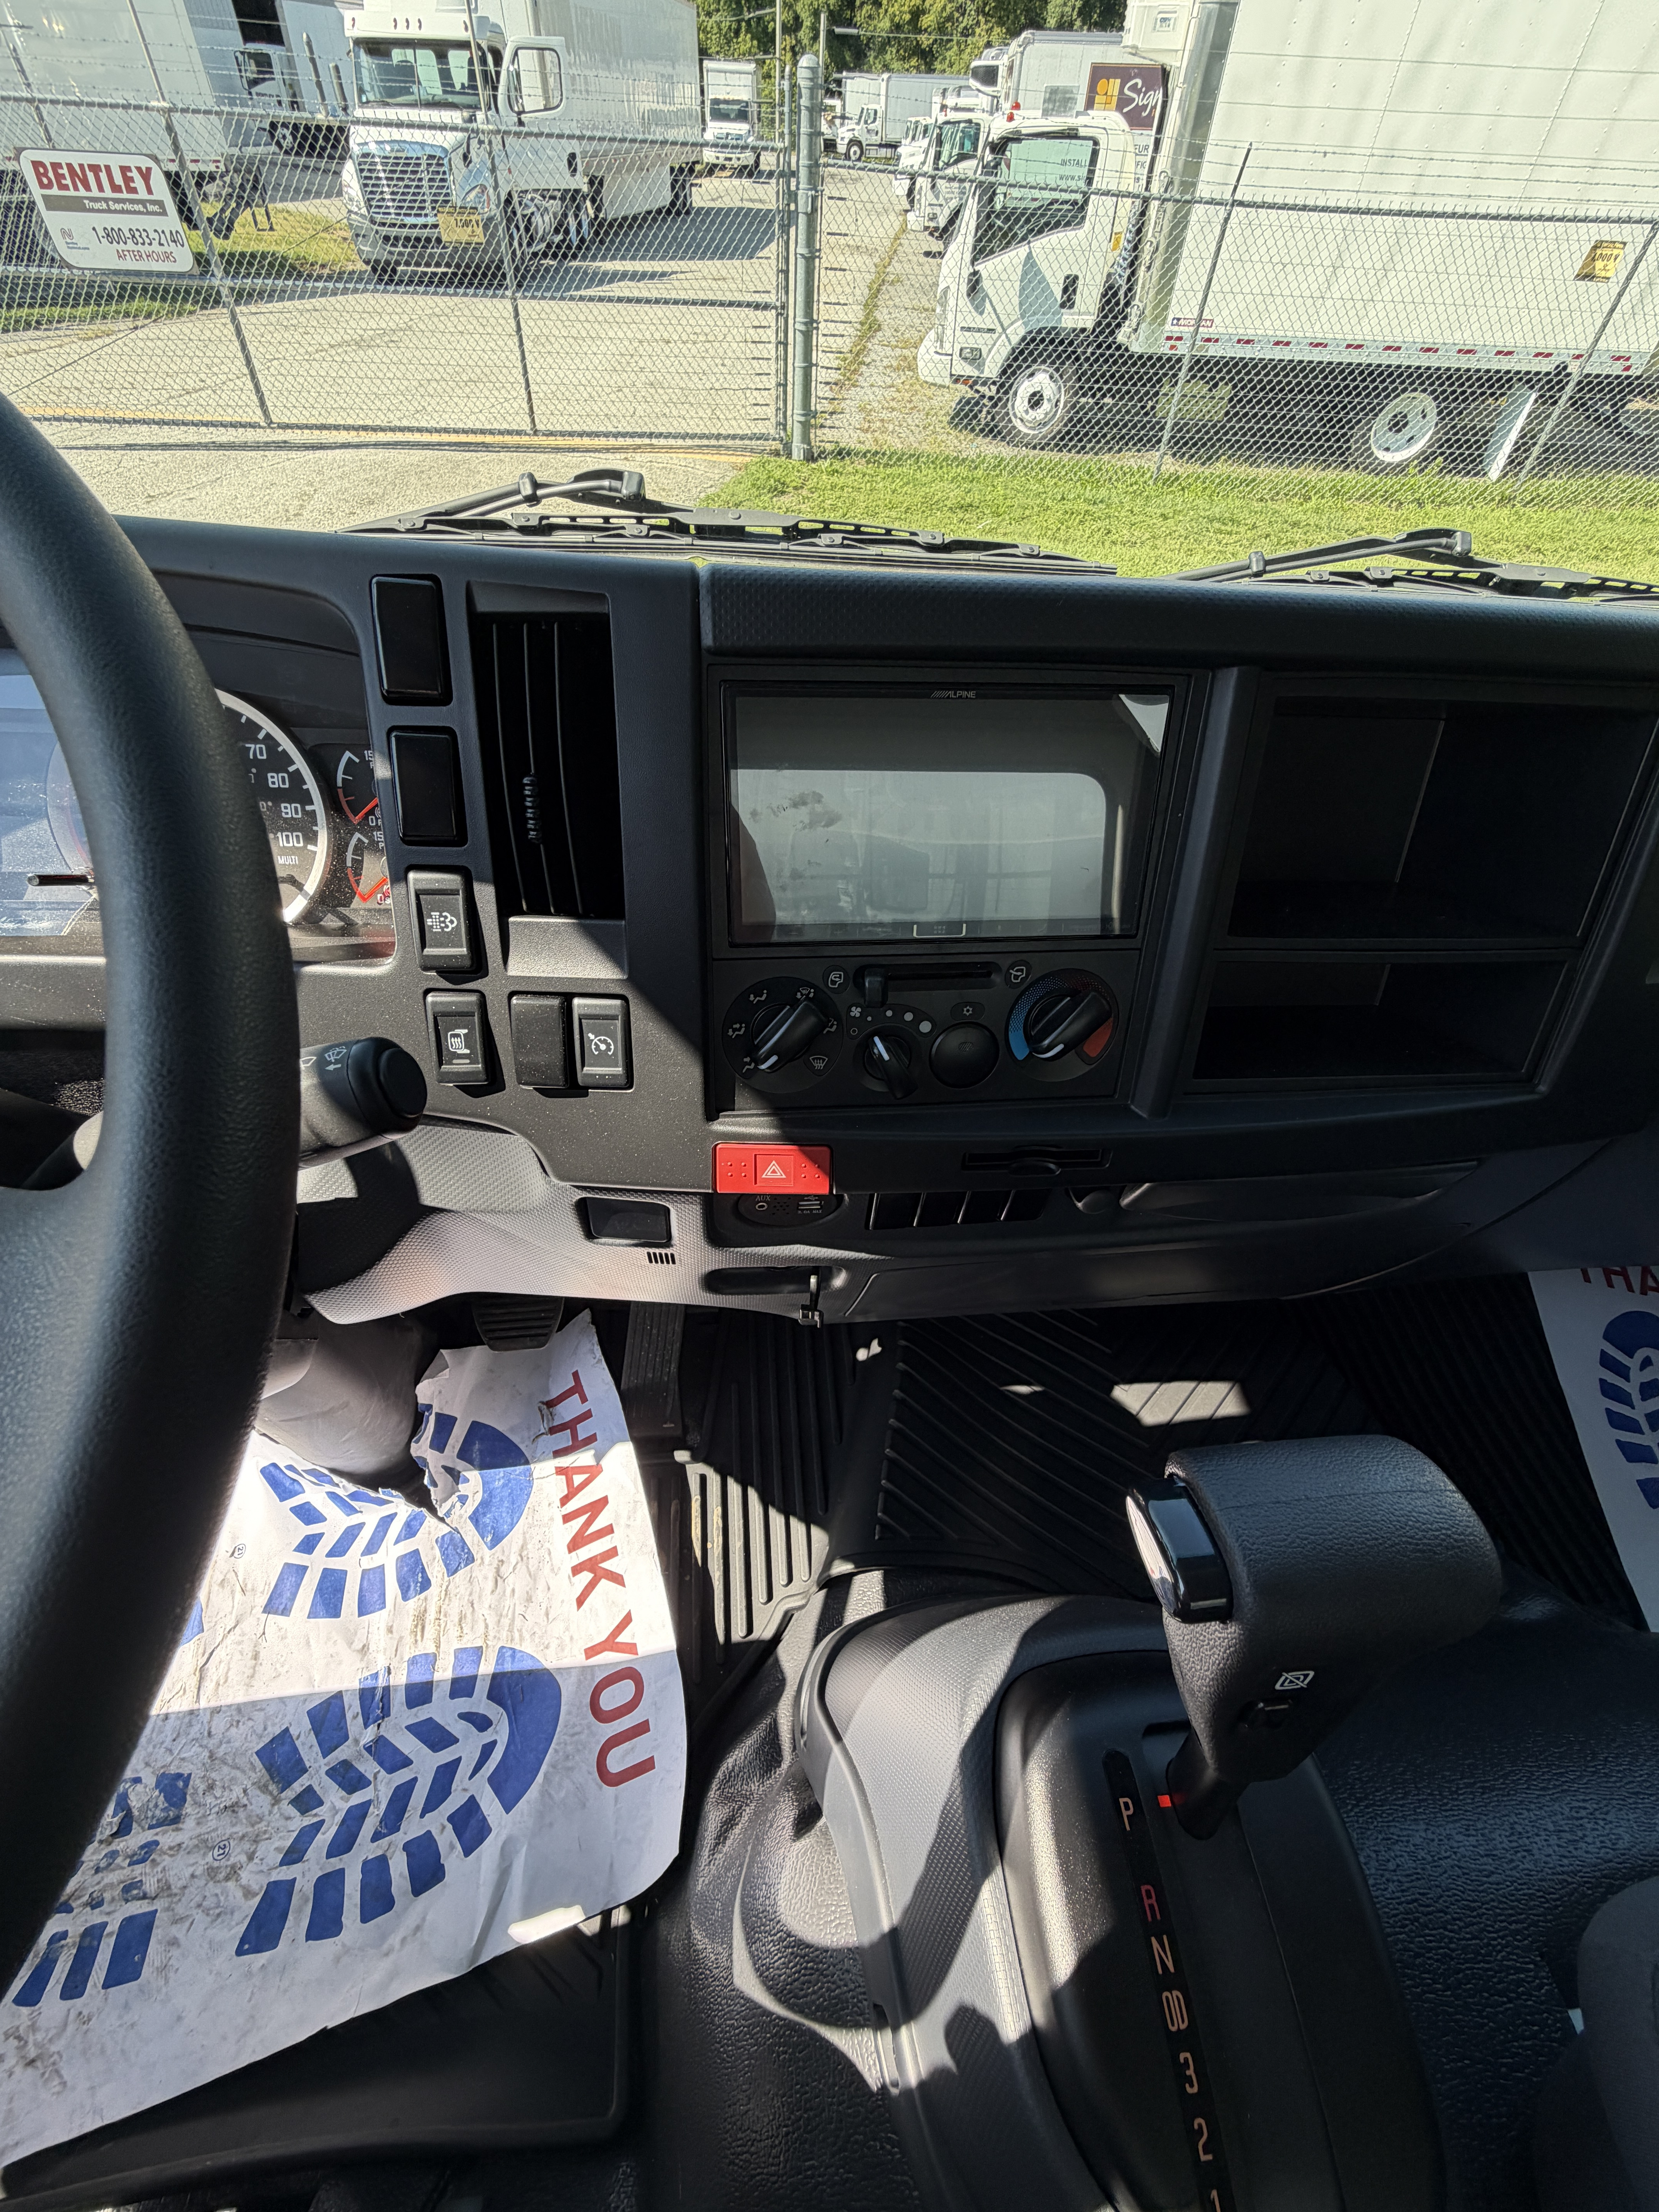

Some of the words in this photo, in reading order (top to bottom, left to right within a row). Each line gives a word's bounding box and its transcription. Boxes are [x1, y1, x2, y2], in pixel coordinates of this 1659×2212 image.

[1061, 158, 1087, 167] INSTALL
[30, 160, 154, 196] BENTLEY
[84, 200, 108, 210] Truck
[108, 201, 146, 212] Services,
[146, 203, 162, 212] Inc.
[92, 227, 185, 248] 1-800-833-2140
[117, 249, 143, 262] AFTER
[146, 251, 177, 263] HOURS
[1178, 318, 1213, 327] MOAN
[245, 744, 266, 759] 70
[267, 773, 289, 788] 80
[281, 803, 302, 818] 90
[276, 832, 303, 847] 100
[278, 855, 298, 865] MULTI
[545, 1370, 626, 1611] THANK
[584, 1609, 656, 1788] YOU
[1119, 1798, 1133, 1831] P
[217, 1844, 226, 1857] 21
[1140, 1885, 1161, 1922] R
[1151, 1935, 1175, 1974] N
[1179, 2052, 1198, 2094] 3
[1194, 2118, 1213, 2162] 2
[1210, 2189, 1221, 2212] 1
